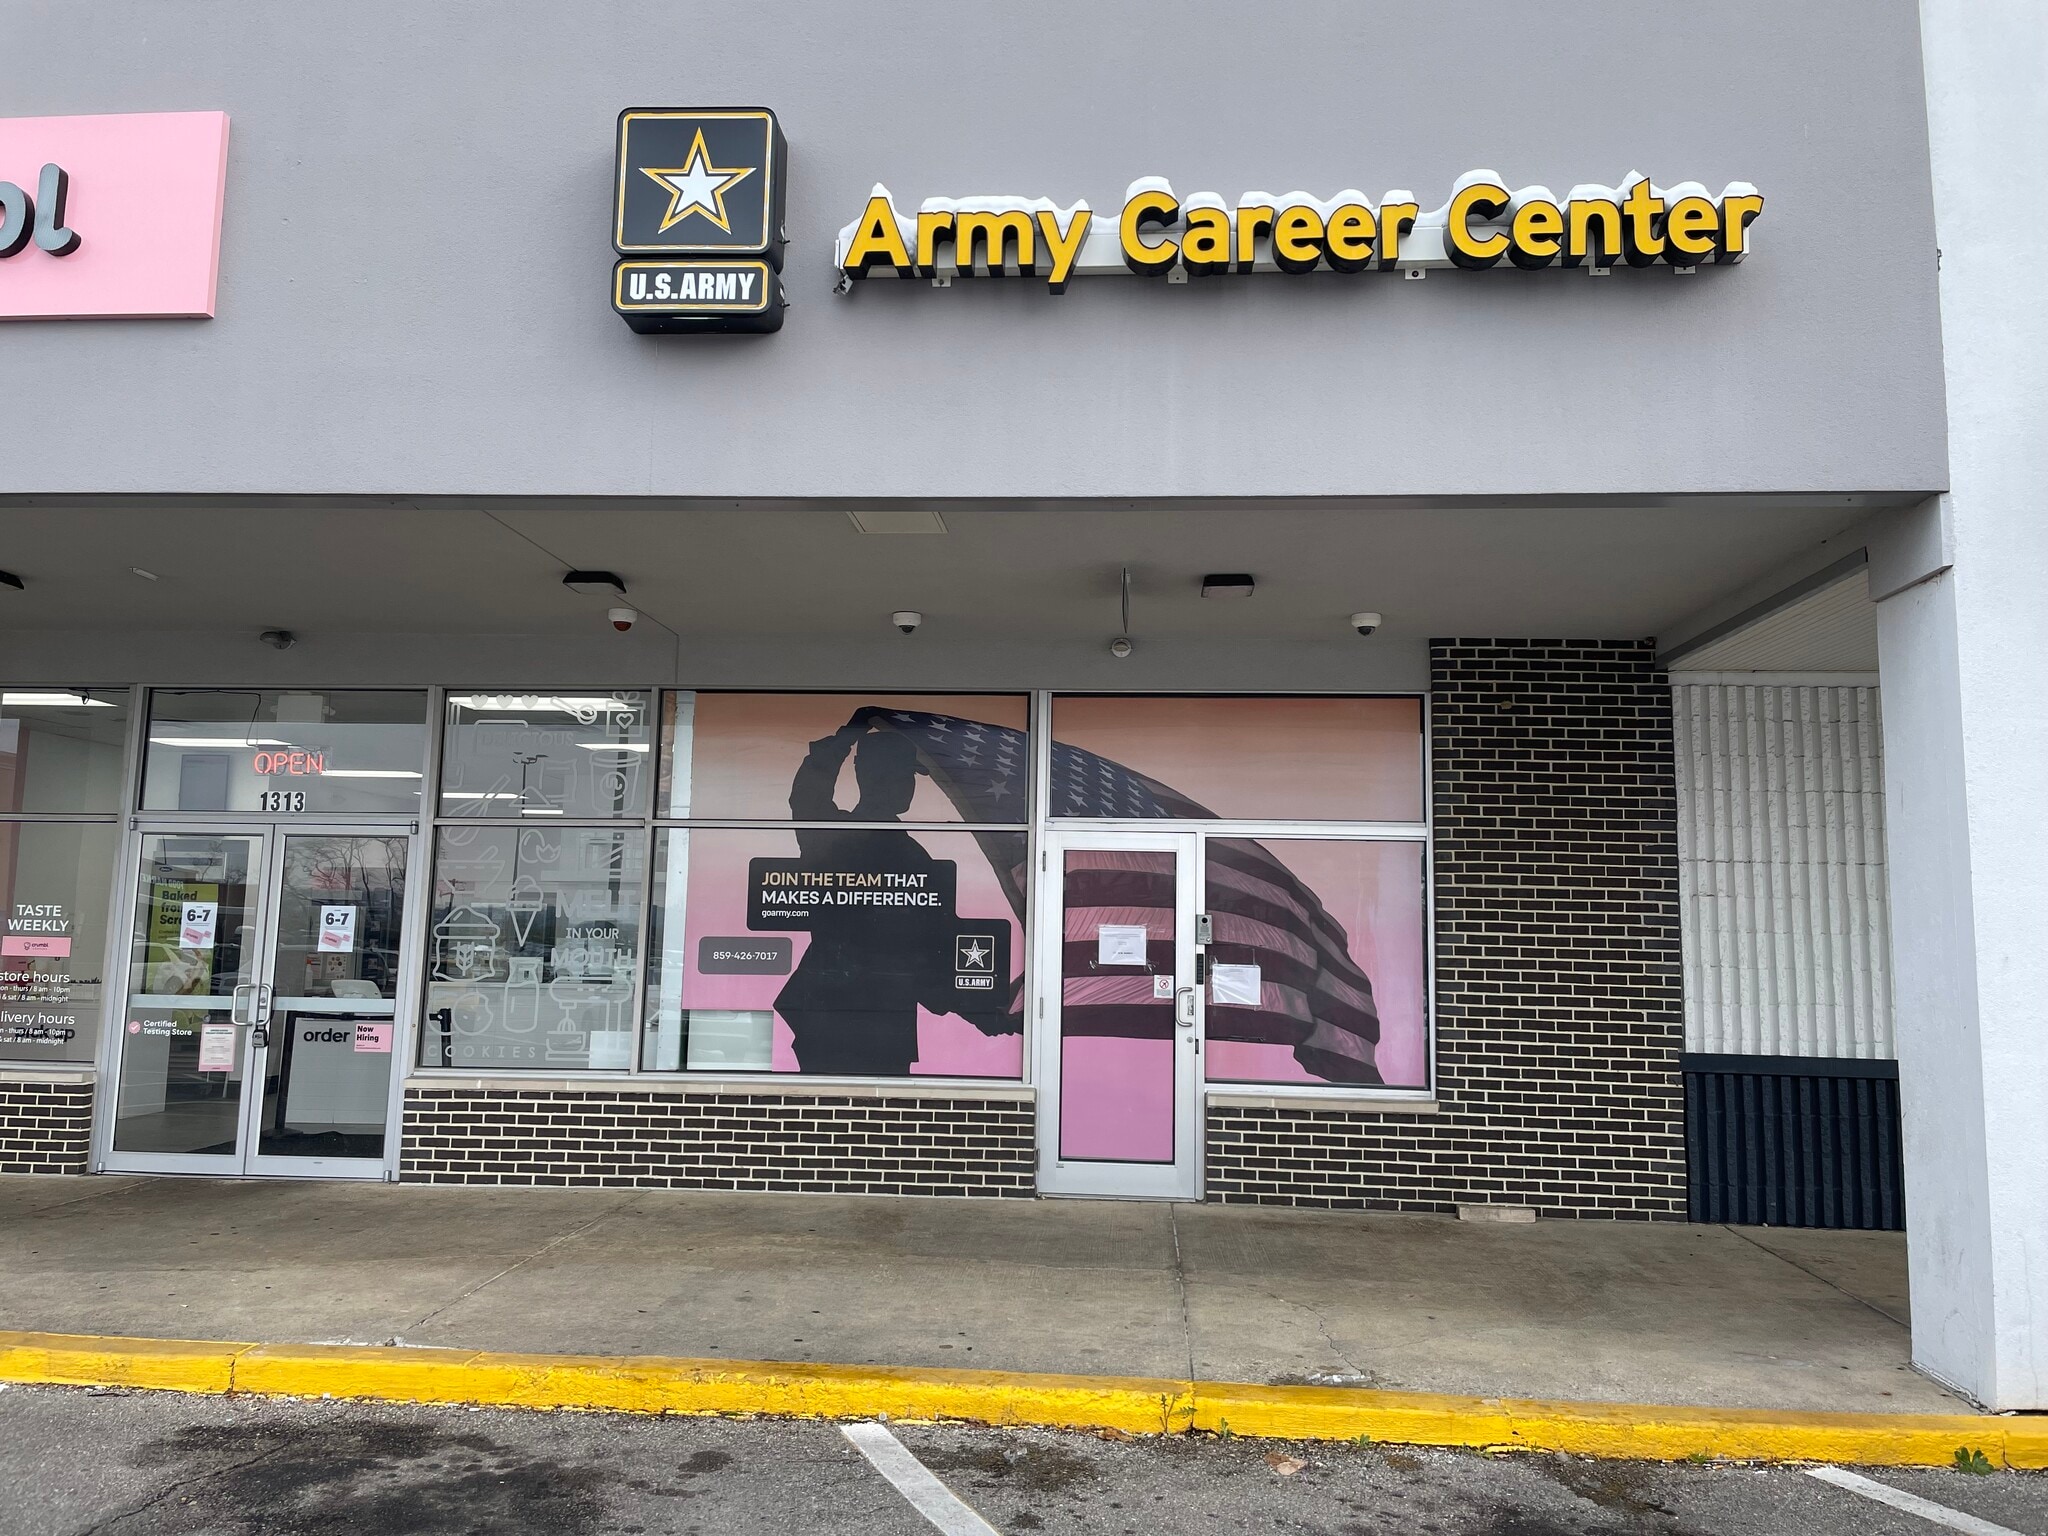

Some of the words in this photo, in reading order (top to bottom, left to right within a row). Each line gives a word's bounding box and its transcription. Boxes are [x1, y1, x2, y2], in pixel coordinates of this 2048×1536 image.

[843, 196, 1093, 291] Army
[1119, 190, 1419, 272] Career
[1449, 177, 1764, 270] Center
[253, 751, 324, 776] OPEN
[260, 791, 305, 812] 1313
[761, 872, 799, 886] JOIN
[801, 872, 834, 886] THE
[835, 872, 881, 887] TEAM
[884, 873, 928, 887] THAT
[162, 890, 199, 901] Baked
[762, 890, 820, 905] MAKES
[821, 891, 835, 905] A
[837, 891, 942, 907] DIFFERENCE.
[16, 904, 62, 917] TASTE
[555, 889, 637, 918] MELT
[186, 908, 211, 922] 6-7
[325, 912, 350, 926] 6-7
[761, 910, 809, 919] goarmy.com
[7, 918, 69, 932] WEEKLY
[565, 927, 581, 939] IN
[585, 927, 620, 939] YOUR
[550, 947, 632, 968] MOUTH
[713, 951, 778, 961] 859-426-7017
[33, 970, 70, 983] hours
[53, 986, 70, 994] 10pm
[38, 1011, 75, 1025] hours
[143, 1019, 178, 1028] Certified
[142, 1027, 171, 1037] Testing
[171, 1029, 193, 1037] Store
[303, 1027, 350, 1043] order
[356, 1025, 375, 1033] Now
[356, 1033, 380, 1043] Hiring
[426, 1044, 536, 1059] COOKIES
